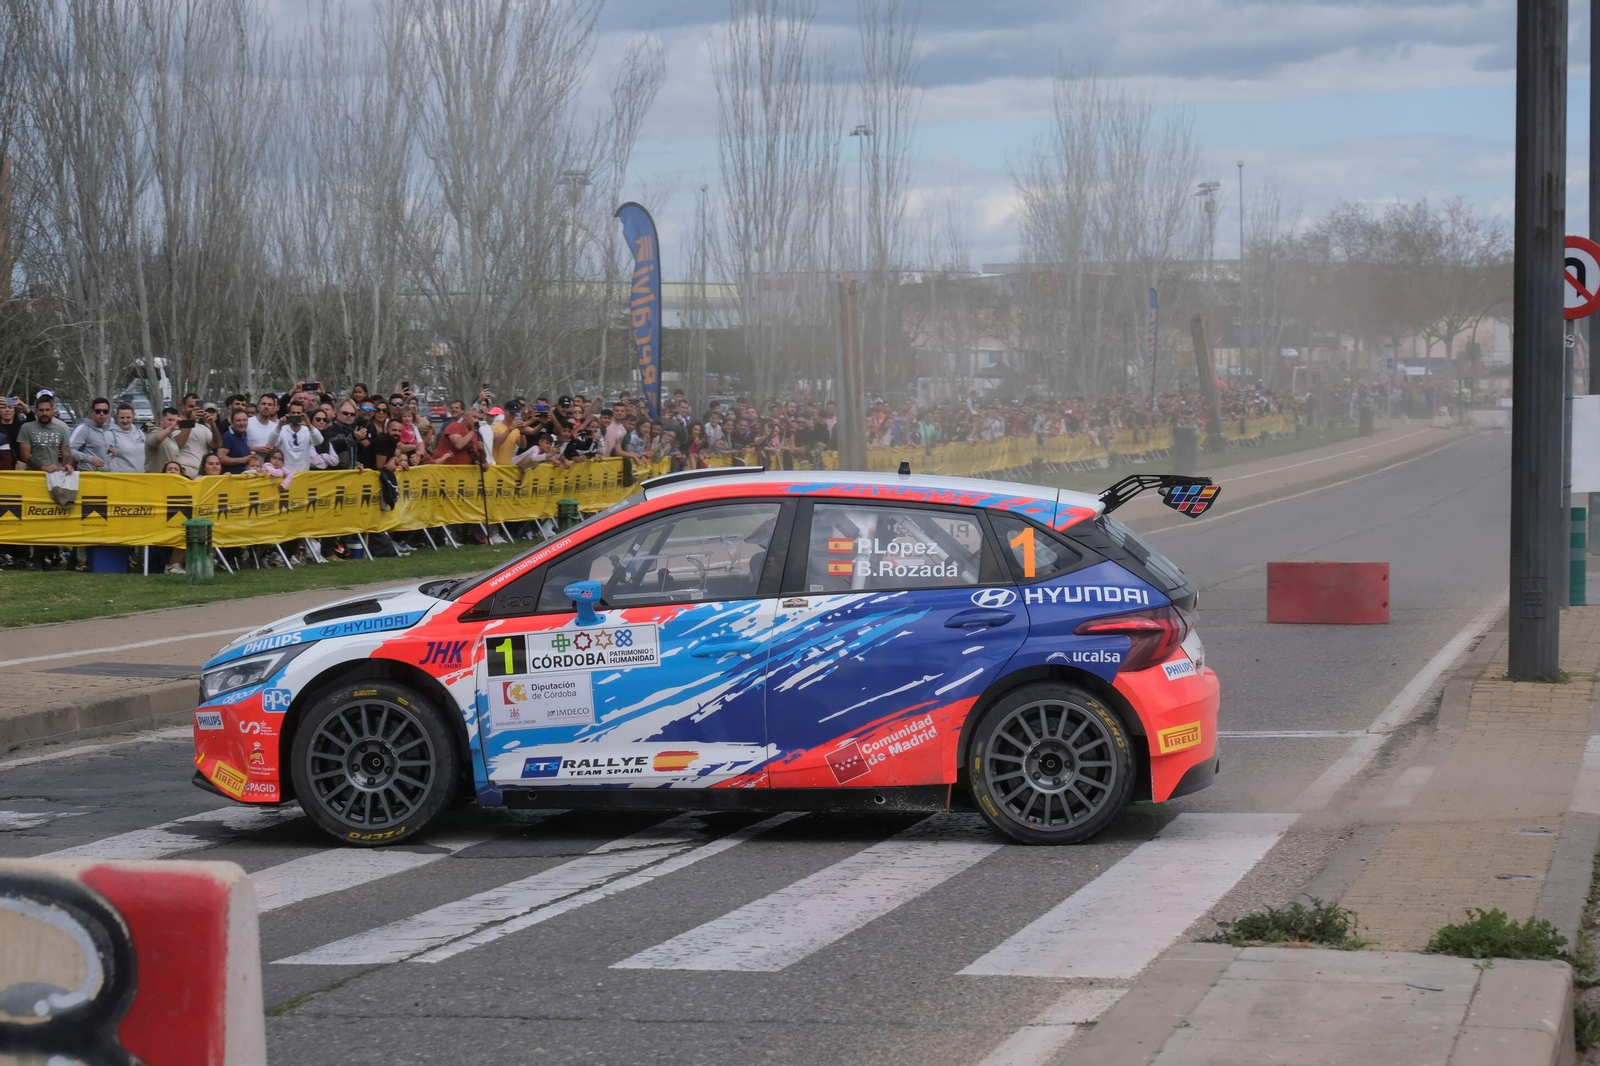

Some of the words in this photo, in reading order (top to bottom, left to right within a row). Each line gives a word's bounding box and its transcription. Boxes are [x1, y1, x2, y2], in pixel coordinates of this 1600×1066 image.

[27, 505, 68, 516] Recalvi
[112, 506, 153, 516] Recalvi
[857, 538, 938, 558] P.López
[1010, 527, 1036, 577] 1
[489, 538, 571, 587] www.msispain.com
[857, 560, 958, 578] B.Rozada
[1024, 586, 1149, 605] HYUNDAI
[343, 614, 409, 633] HYUNDAI
[242, 632, 303, 655] PHILIPS
[418, 640, 469, 665] JHK
[609, 648, 649, 657] PATRIMONIO
[495, 638, 514, 675] 1
[531, 652, 606, 670] CÓRDOBA
[609, 654, 655, 664] HUMANIDAD
[1072, 650, 1121, 663] ucalsa
[1165, 661, 1193, 677] PHILIPS
[531, 681, 576, 693] Diputación
[531, 692, 542, 700] de
[543, 689, 577, 699] Córdoba
[264, 690, 291, 710] PPG
[197, 715, 222, 727] PHILIPS
[556, 707, 590, 717] IMDECO
[861, 714, 934, 754] Comunidad
[1162, 726, 1199, 749] PIRELLI
[867, 752, 887, 766] de
[887, 725, 939, 757] Madrid
[523, 761, 560, 772] RTS
[562, 756, 649, 769] RALLYE
[214, 765, 244, 792] PIRELLI
[568, 769, 602, 777] TEAM
[605, 767, 643, 775] SPAIN
[250, 782, 276, 793] PAGID
